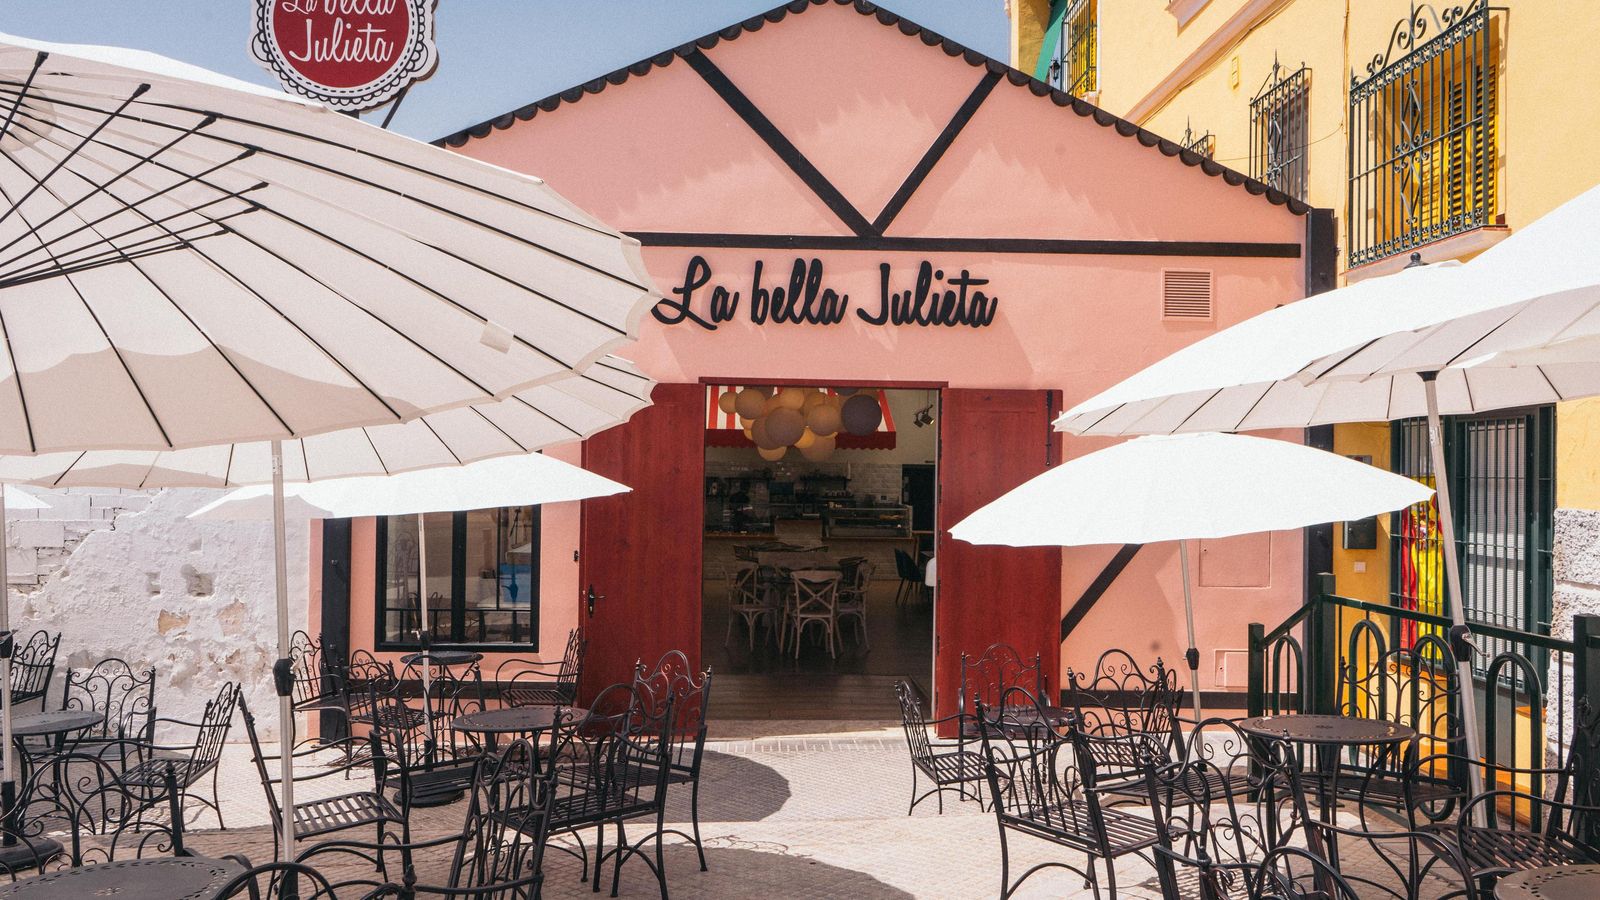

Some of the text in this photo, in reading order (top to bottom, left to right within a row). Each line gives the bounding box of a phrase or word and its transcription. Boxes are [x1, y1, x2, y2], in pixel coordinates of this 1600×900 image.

[288, 16, 394, 63] Julieta
[650, 255, 998, 331] La bella Julieta
